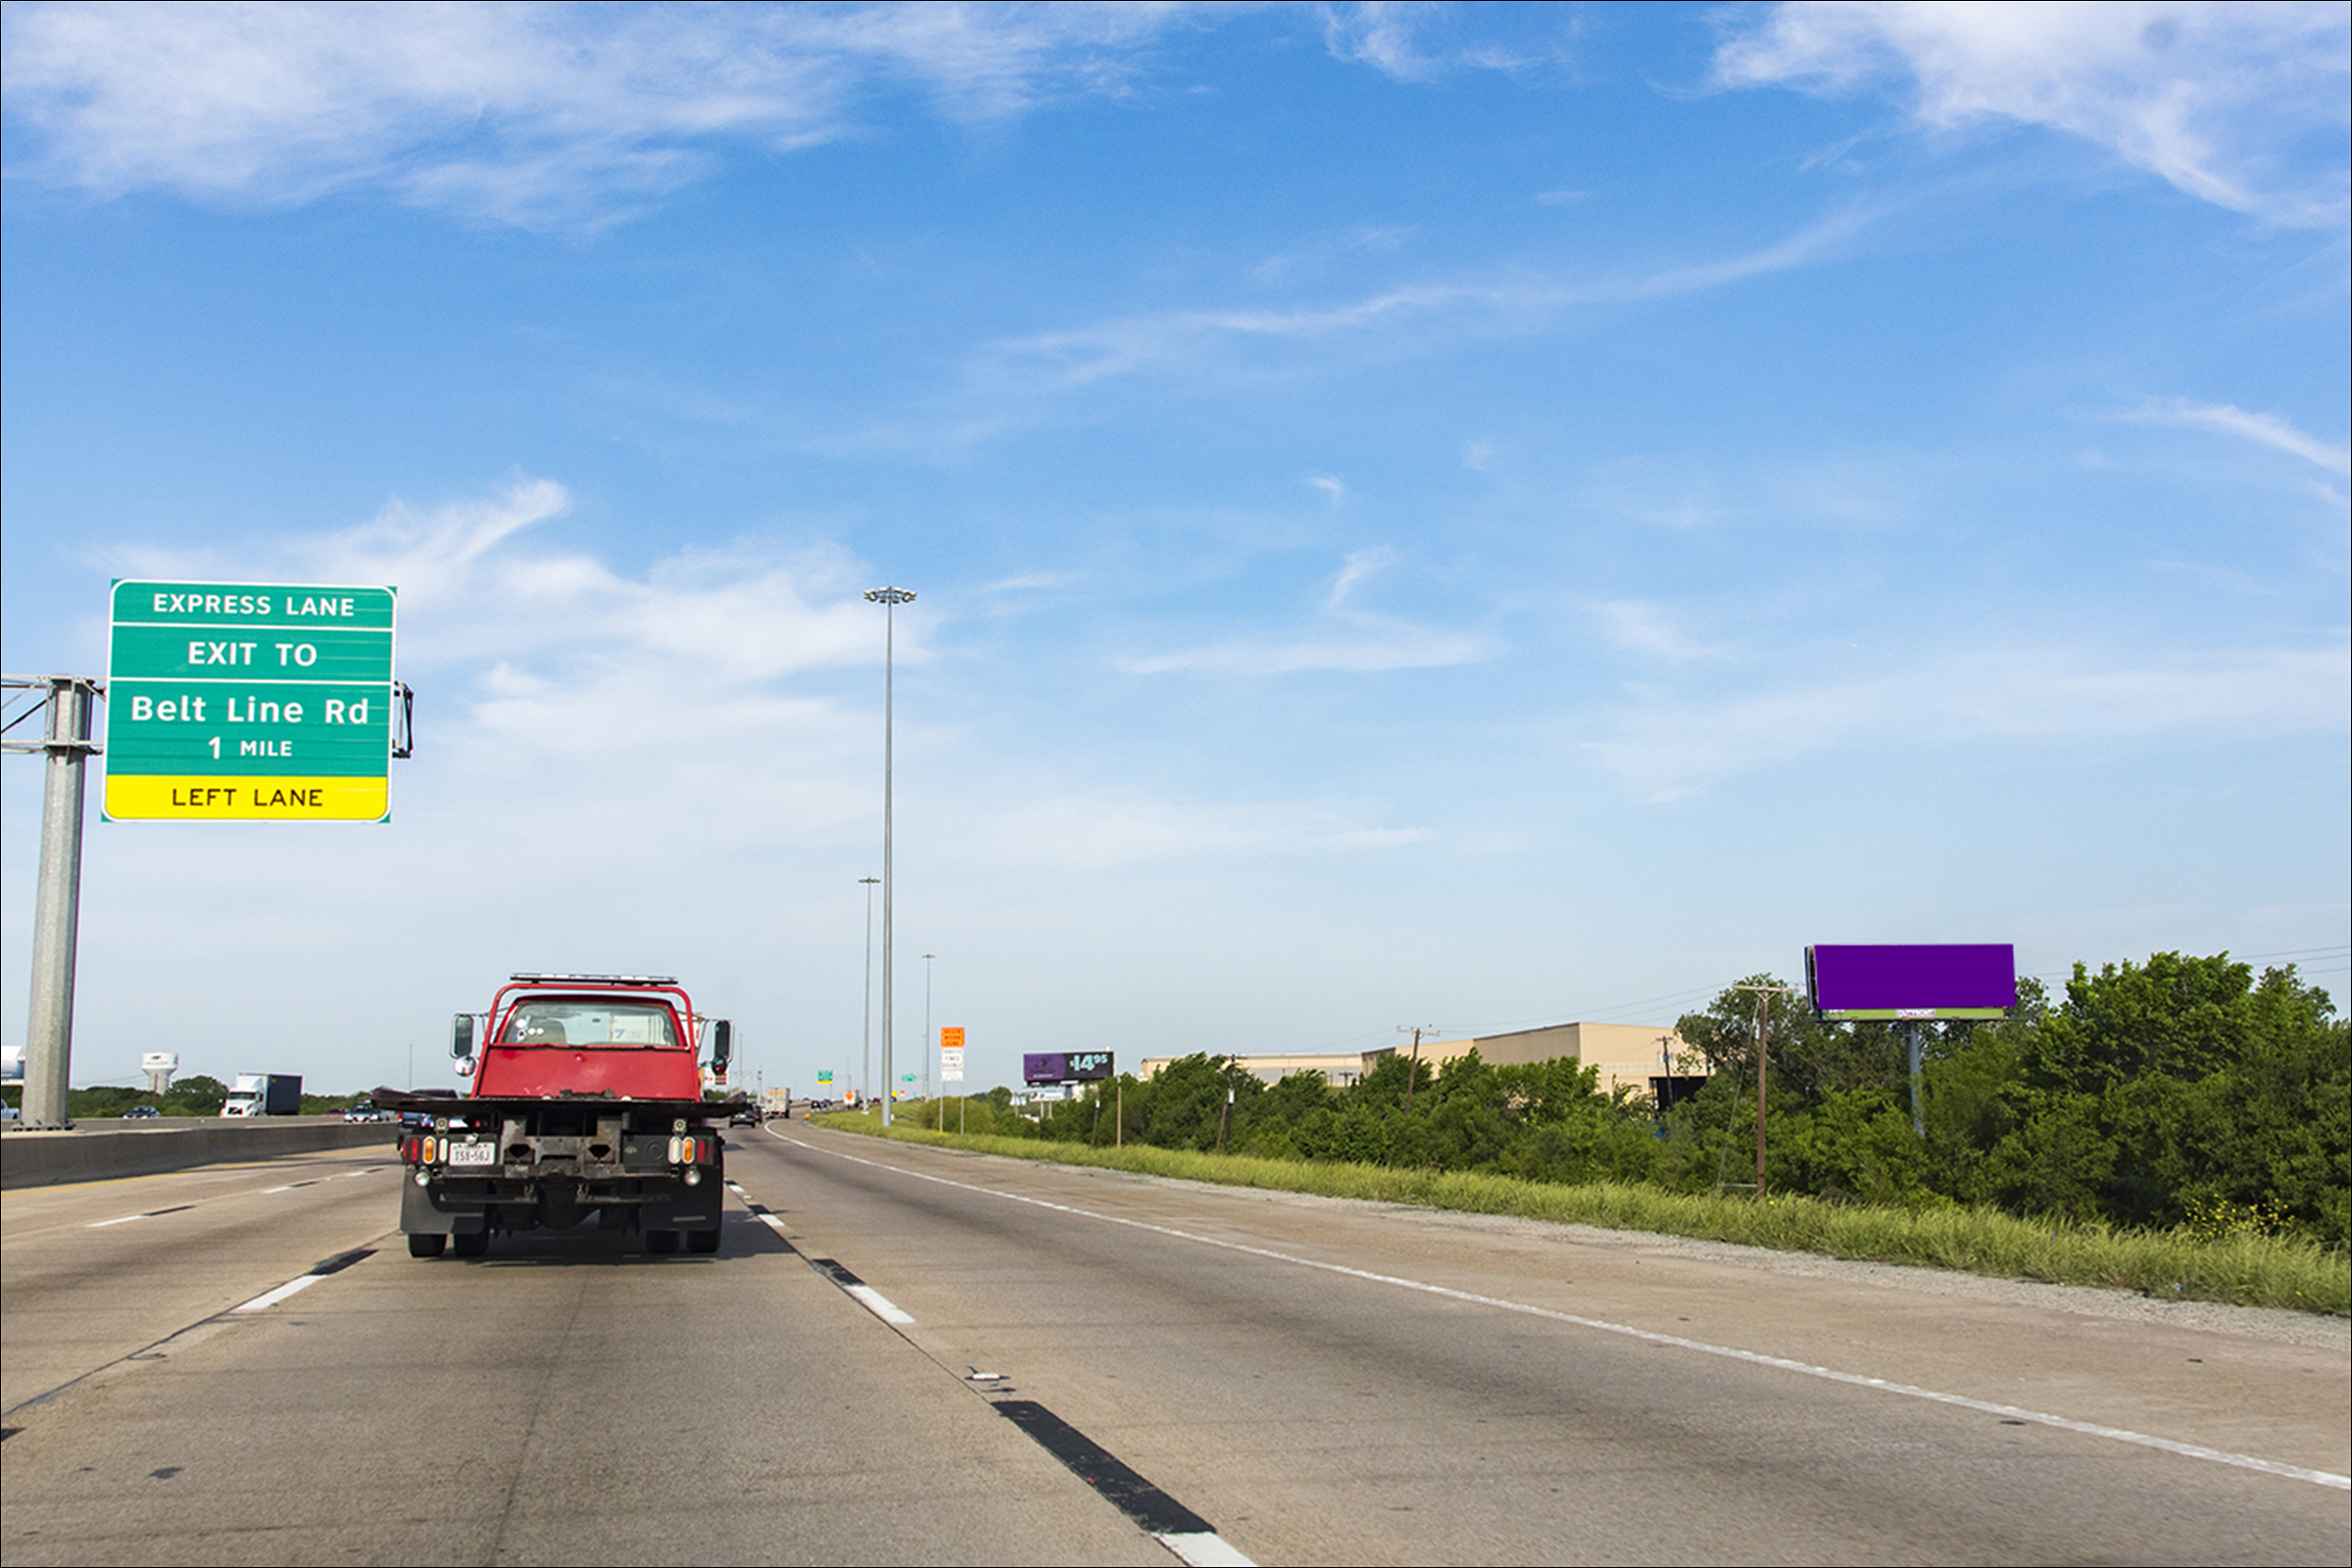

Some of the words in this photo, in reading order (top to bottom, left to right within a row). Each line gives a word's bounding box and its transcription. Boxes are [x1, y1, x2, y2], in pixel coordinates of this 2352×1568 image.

[153, 593, 271, 614] EXPRESS
[285, 596, 355, 616] LANE
[187, 641, 258, 665] EXIT
[274, 643, 318, 666] TO
[130, 694, 207, 722] Belt
[226, 695, 304, 723] Line
[324, 697, 368, 724] Rd
[208, 736, 220, 760] 1
[239, 740, 292, 757] MILE
[172, 788, 237, 807] LEFT
[253, 789, 323, 807] LANE
